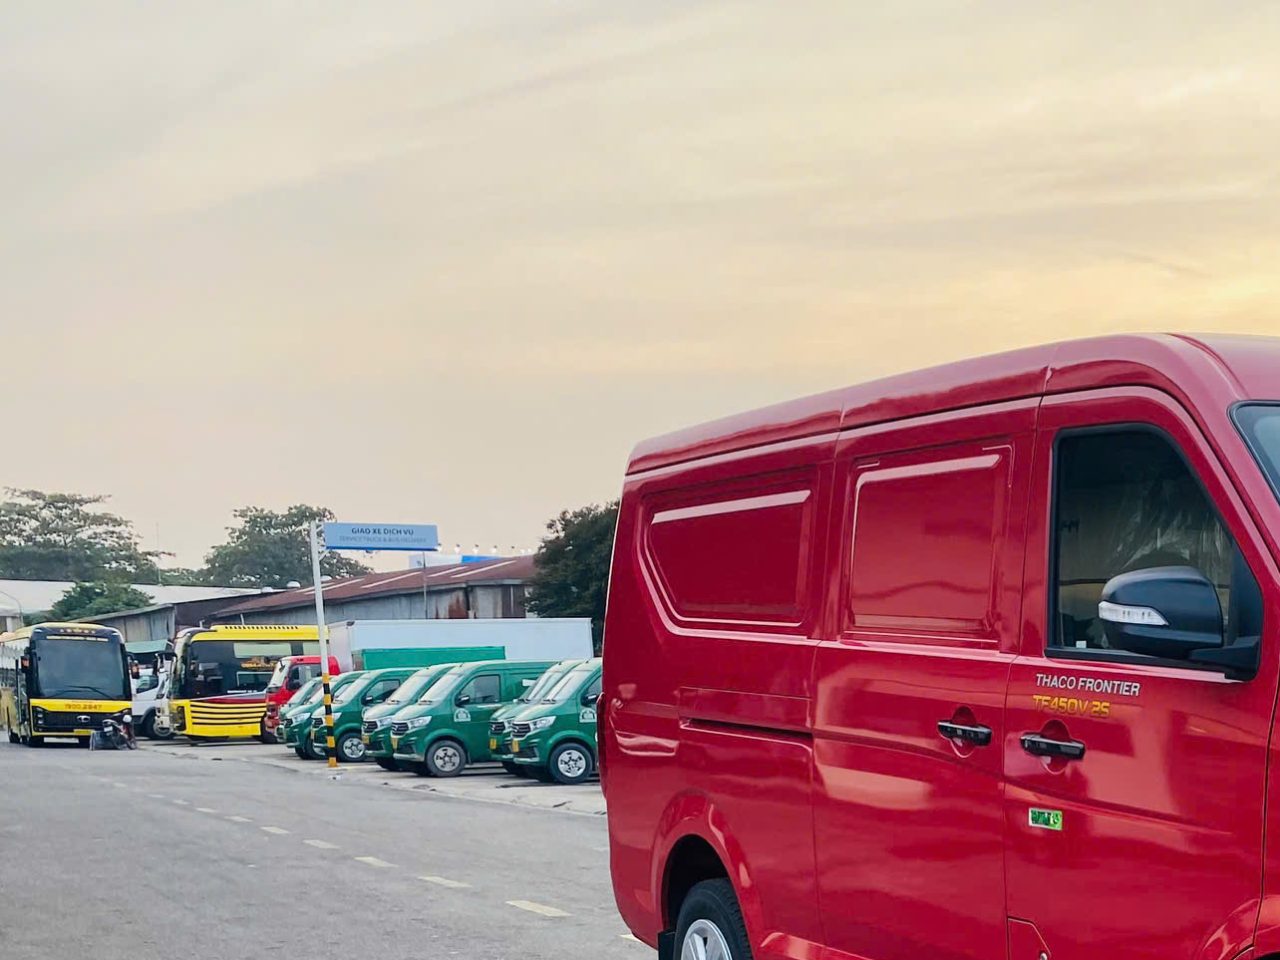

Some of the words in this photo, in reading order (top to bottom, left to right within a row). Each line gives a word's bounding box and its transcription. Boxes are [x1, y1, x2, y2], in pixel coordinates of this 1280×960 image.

[351, 527, 371, 535] GIAO
[1036, 673, 1076, 690] THACO
[1077, 677, 1140, 697] FRONTIER
